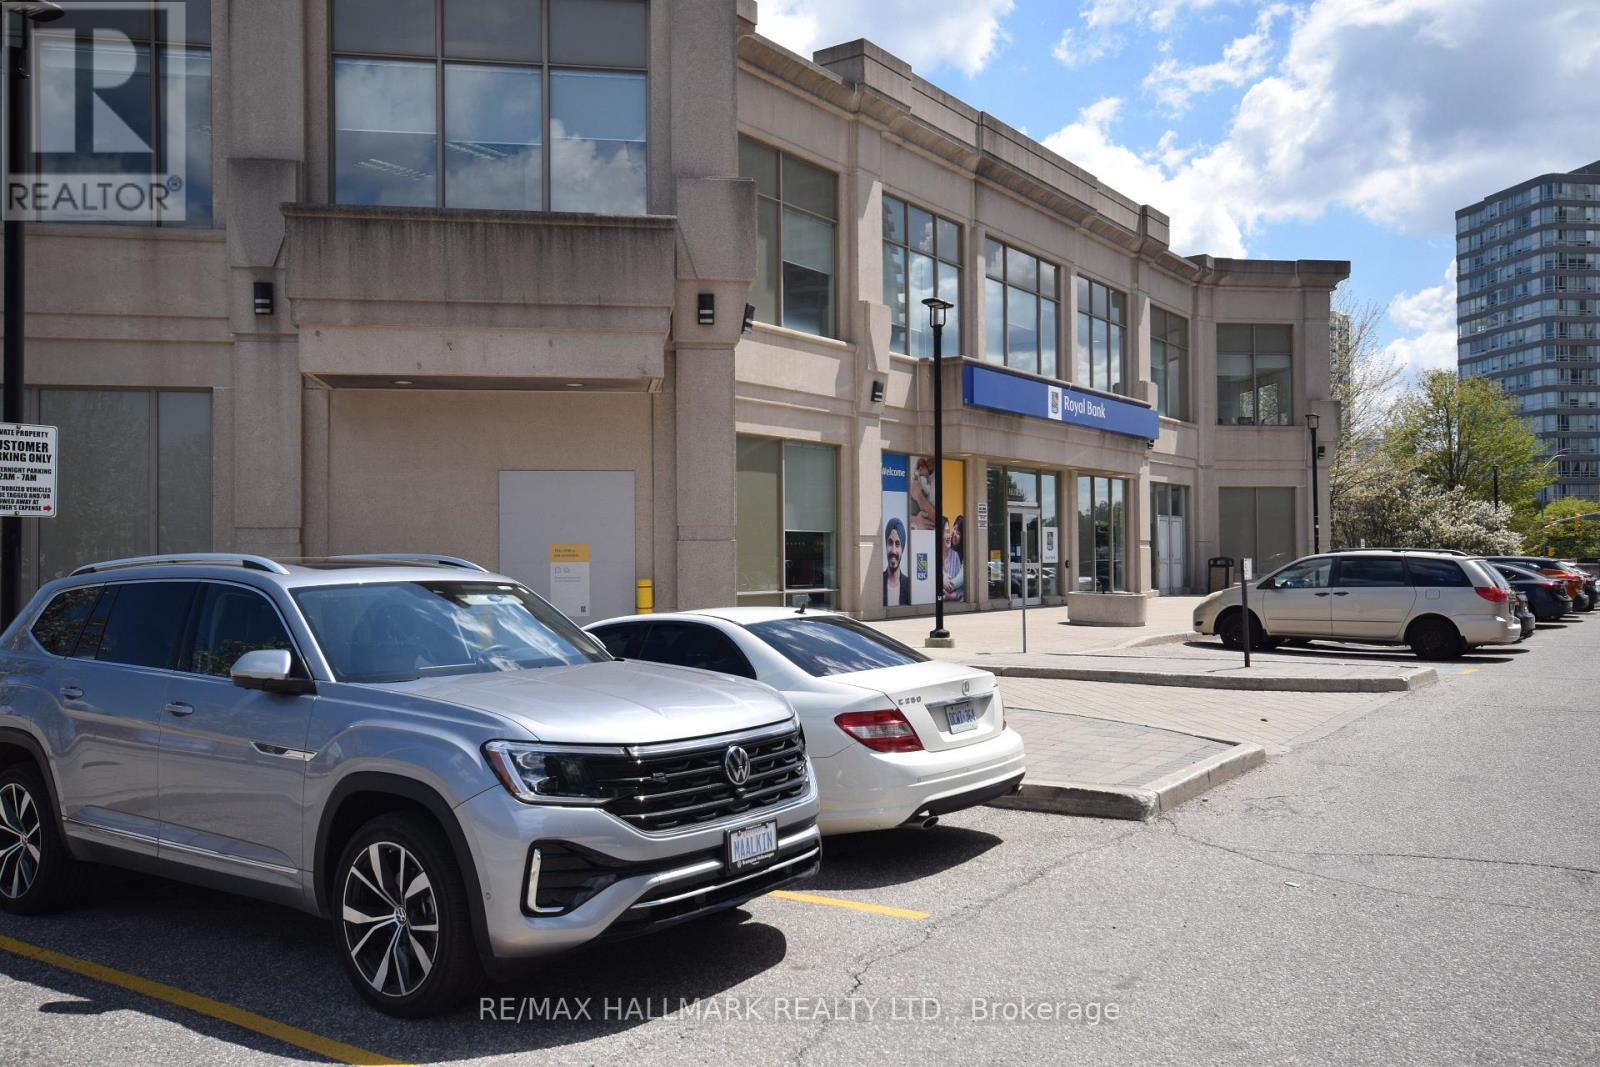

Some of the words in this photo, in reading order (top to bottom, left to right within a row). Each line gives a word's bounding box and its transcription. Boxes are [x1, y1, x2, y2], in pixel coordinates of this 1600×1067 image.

[1064, 396, 1086, 416] Royal
[1087, 401, 1106, 419] Bank
[16, 430, 48, 438] PROPERTY
[29, 453, 52, 463] ONLY
[27, 467, 52, 475] PARKING
[882, 466, 906, 477] Welcome
[733, 831, 773, 861] MAALKIN
